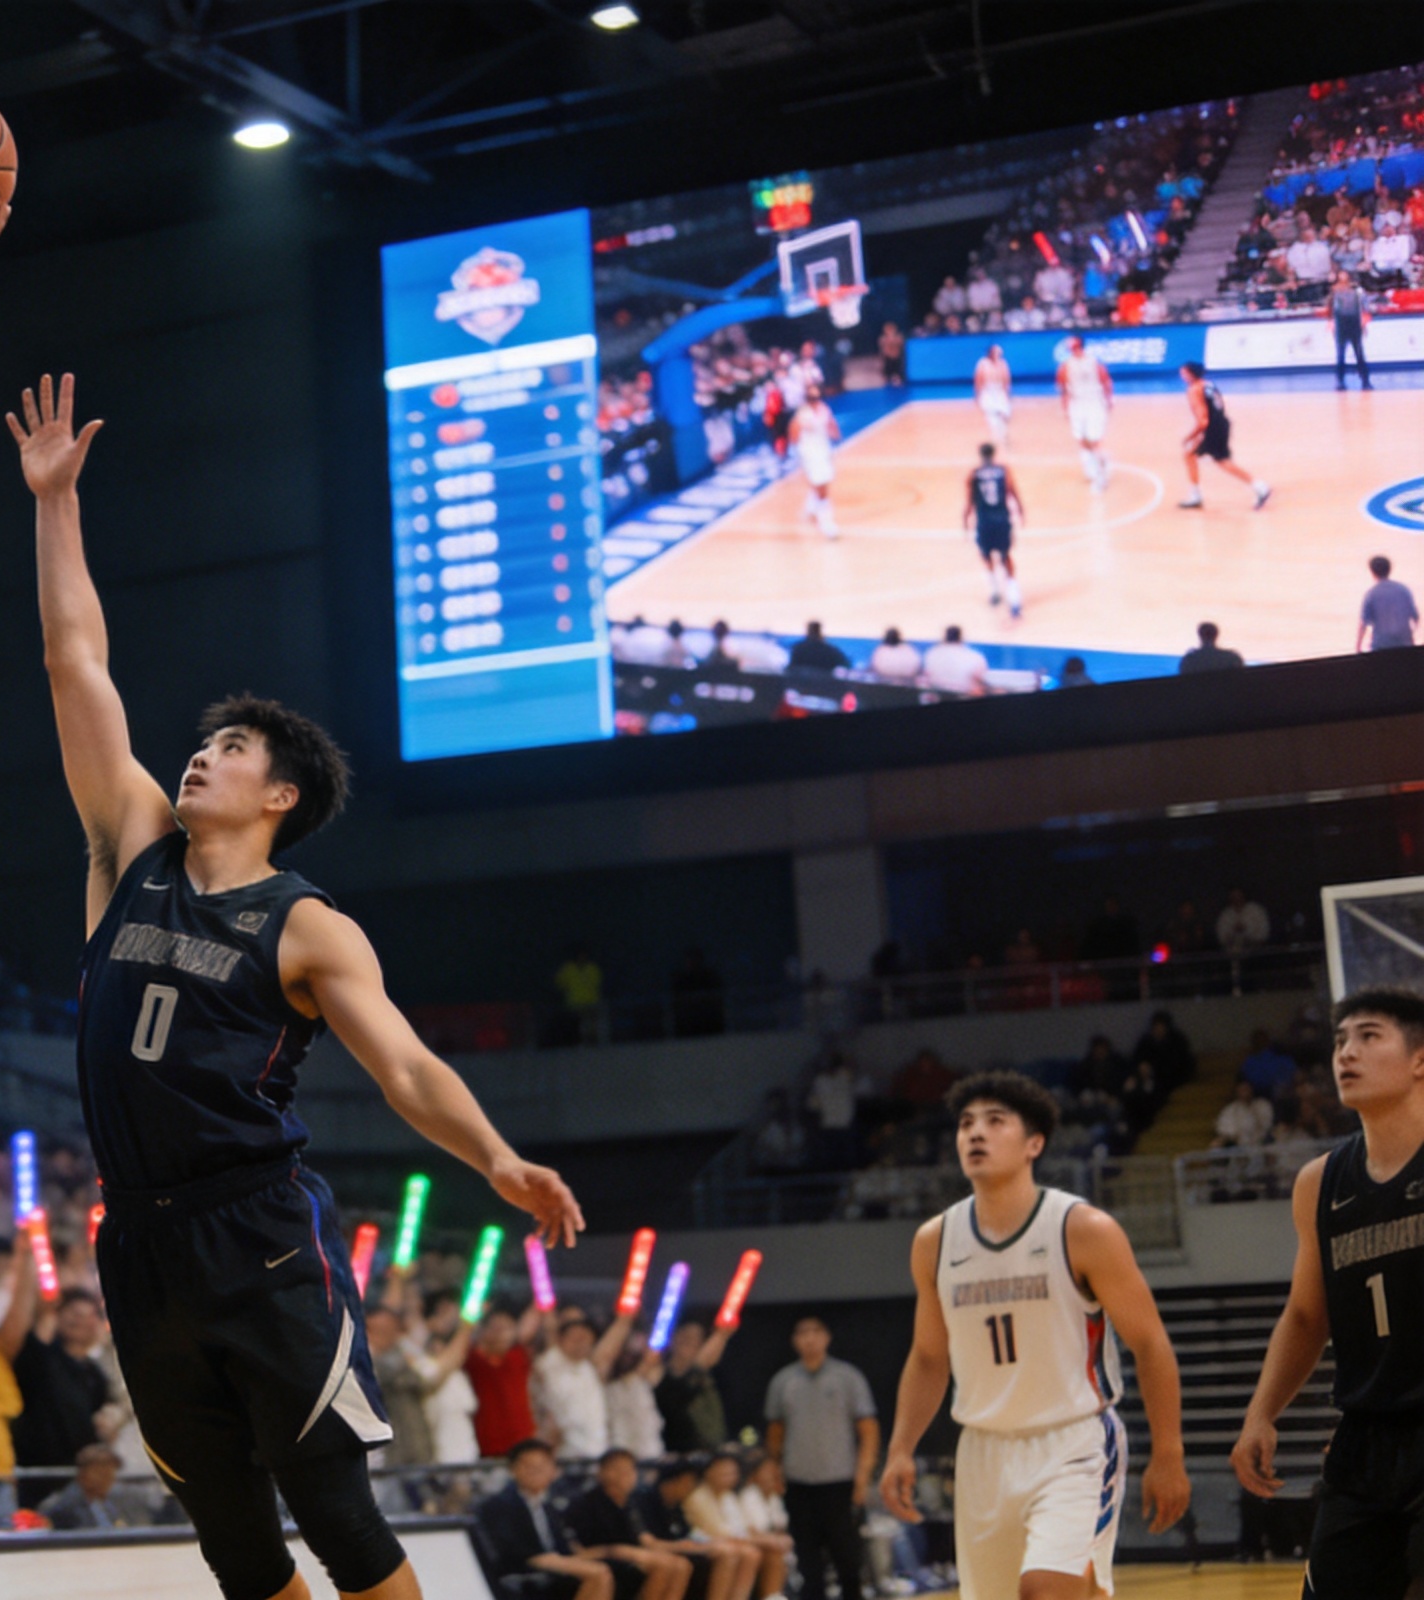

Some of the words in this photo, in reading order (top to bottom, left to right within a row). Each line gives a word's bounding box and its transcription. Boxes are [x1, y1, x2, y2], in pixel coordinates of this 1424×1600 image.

[131, 983, 179, 1062] 0
[1366, 1273, 1391, 1337] 1
[985, 1313, 1016, 1365] 11
